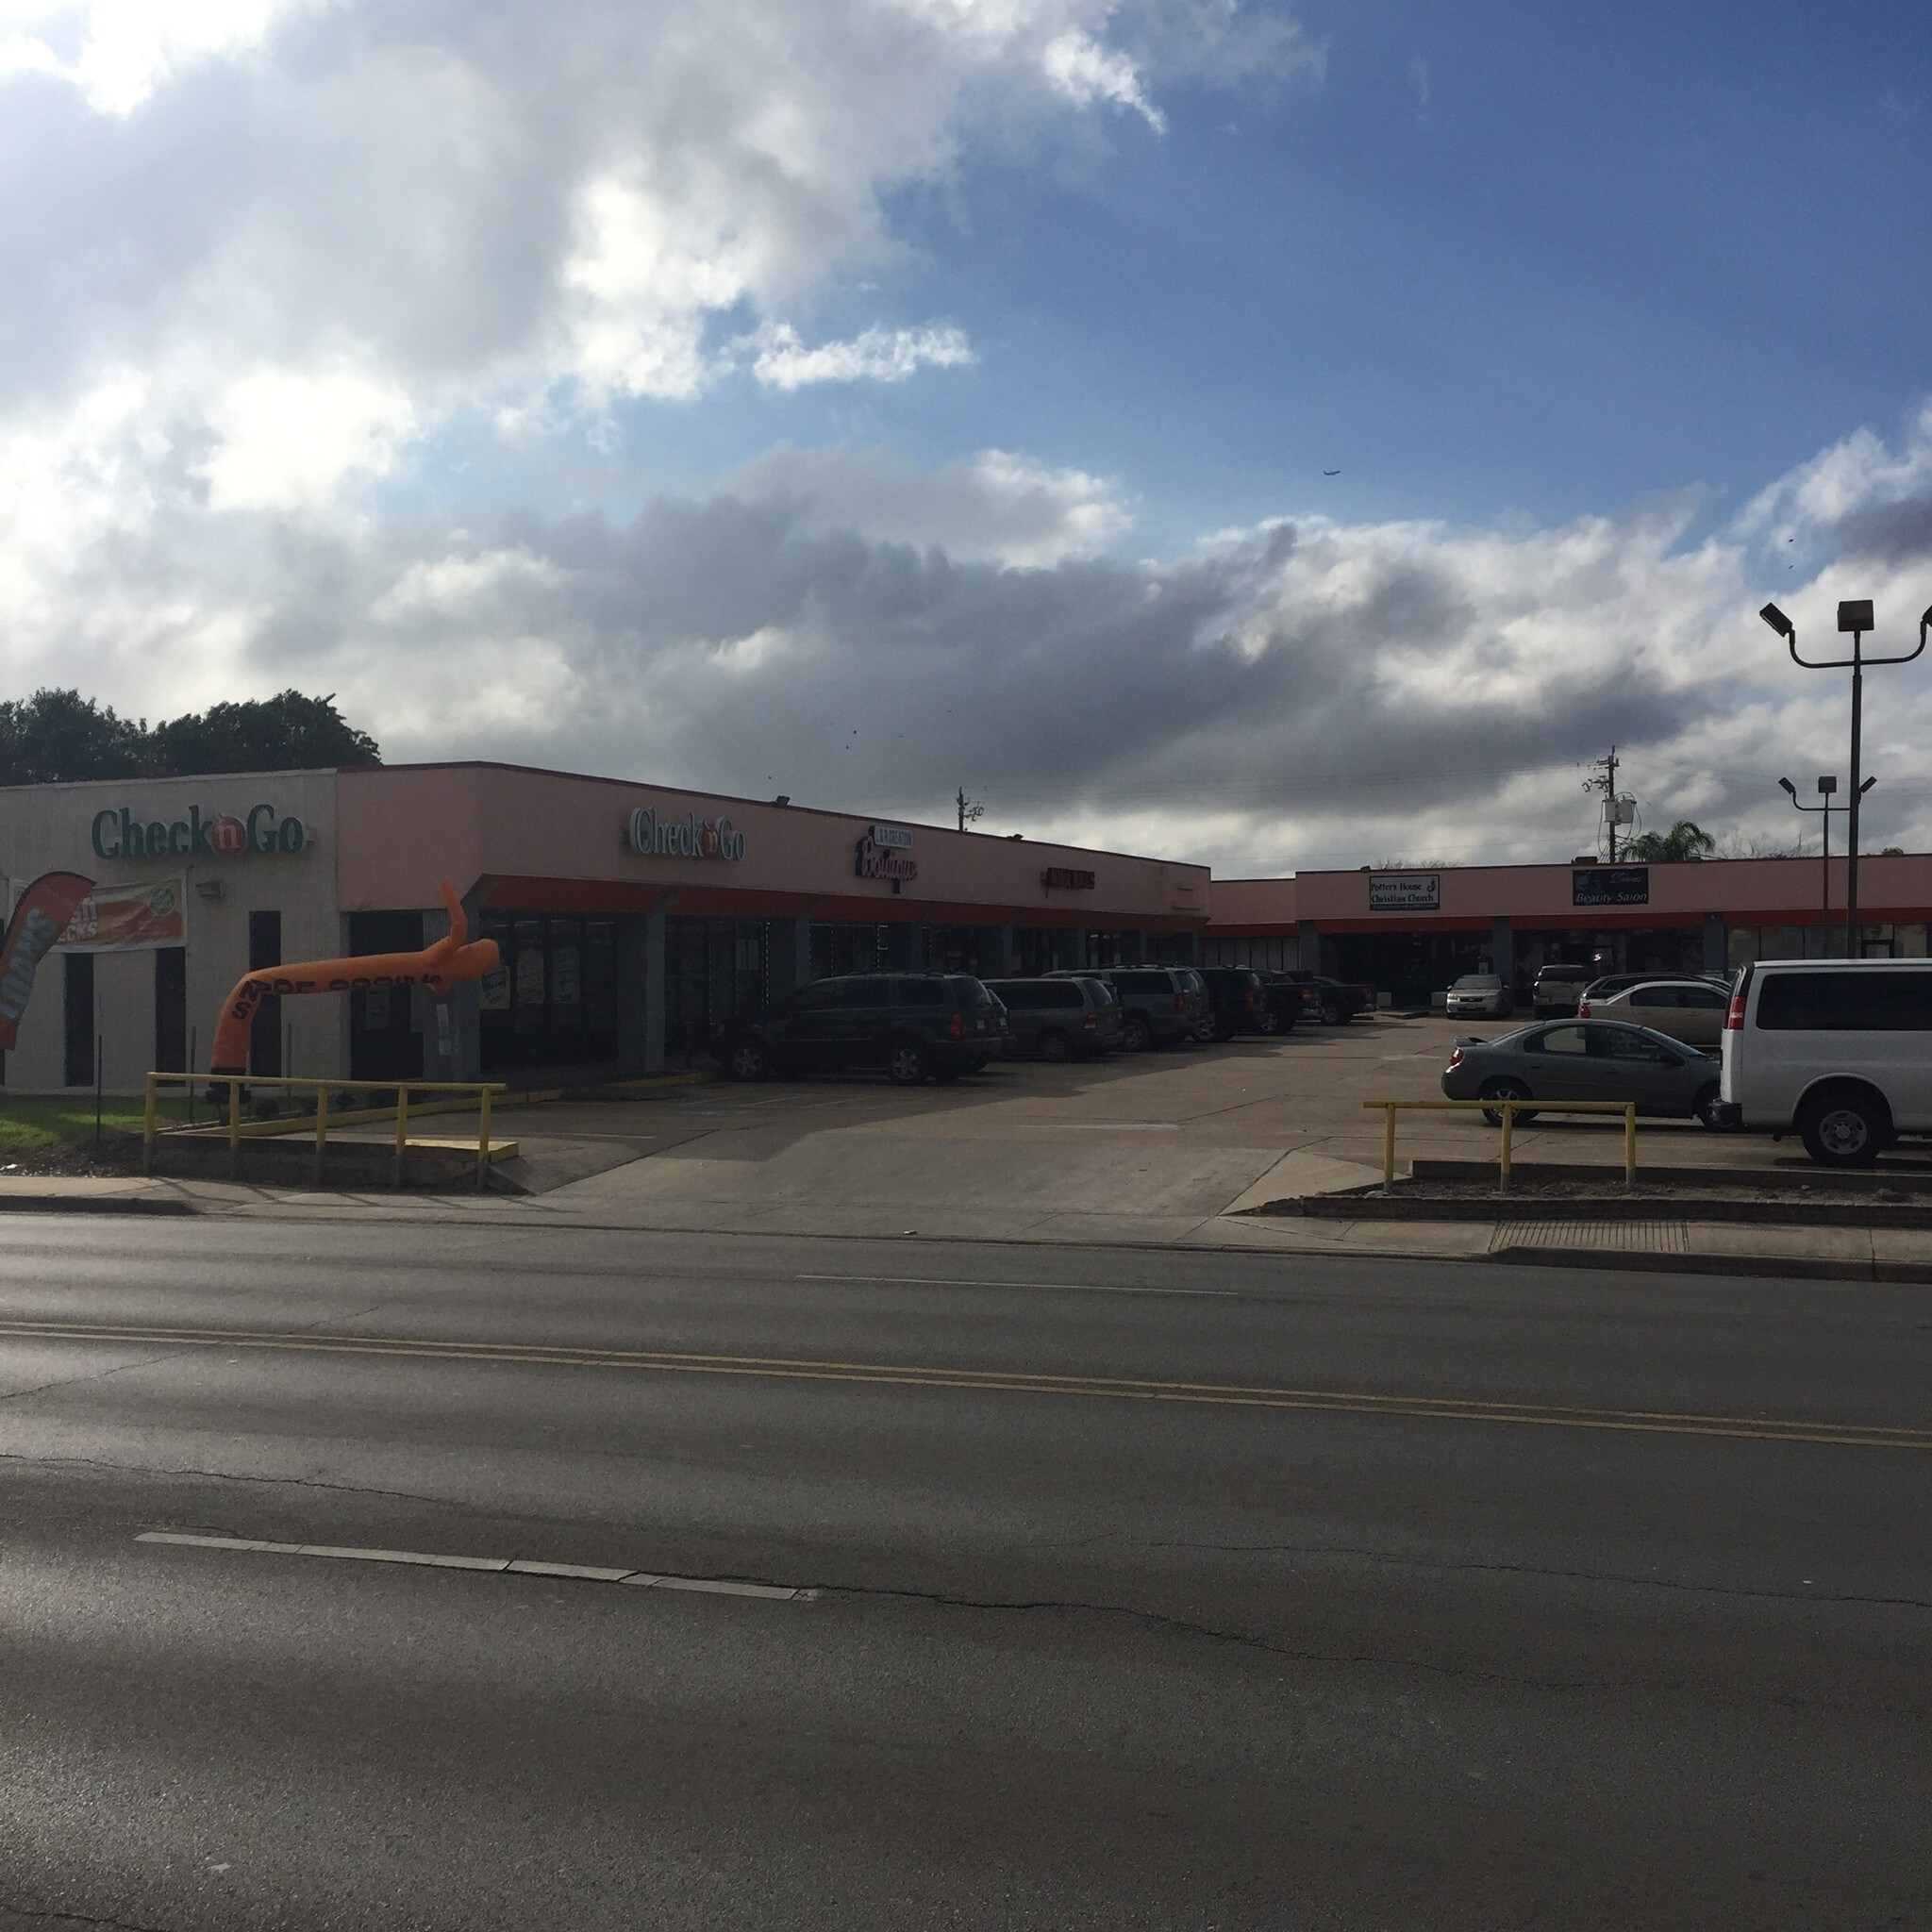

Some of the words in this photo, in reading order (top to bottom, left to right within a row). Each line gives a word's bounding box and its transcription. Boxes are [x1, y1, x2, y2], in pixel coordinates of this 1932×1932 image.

[92, 805, 215, 859] Check
[246, 804, 303, 854] Go
[630, 807, 704, 858] Check
[717, 817, 745, 860] Go
[1400, 882, 1423, 891] House
[1372, 894, 1406, 903] Christian
[1408, 893, 1434, 903] Church
[1576, 892, 1612, 904] Beauty
[1616, 891, 1647, 902] Salon
